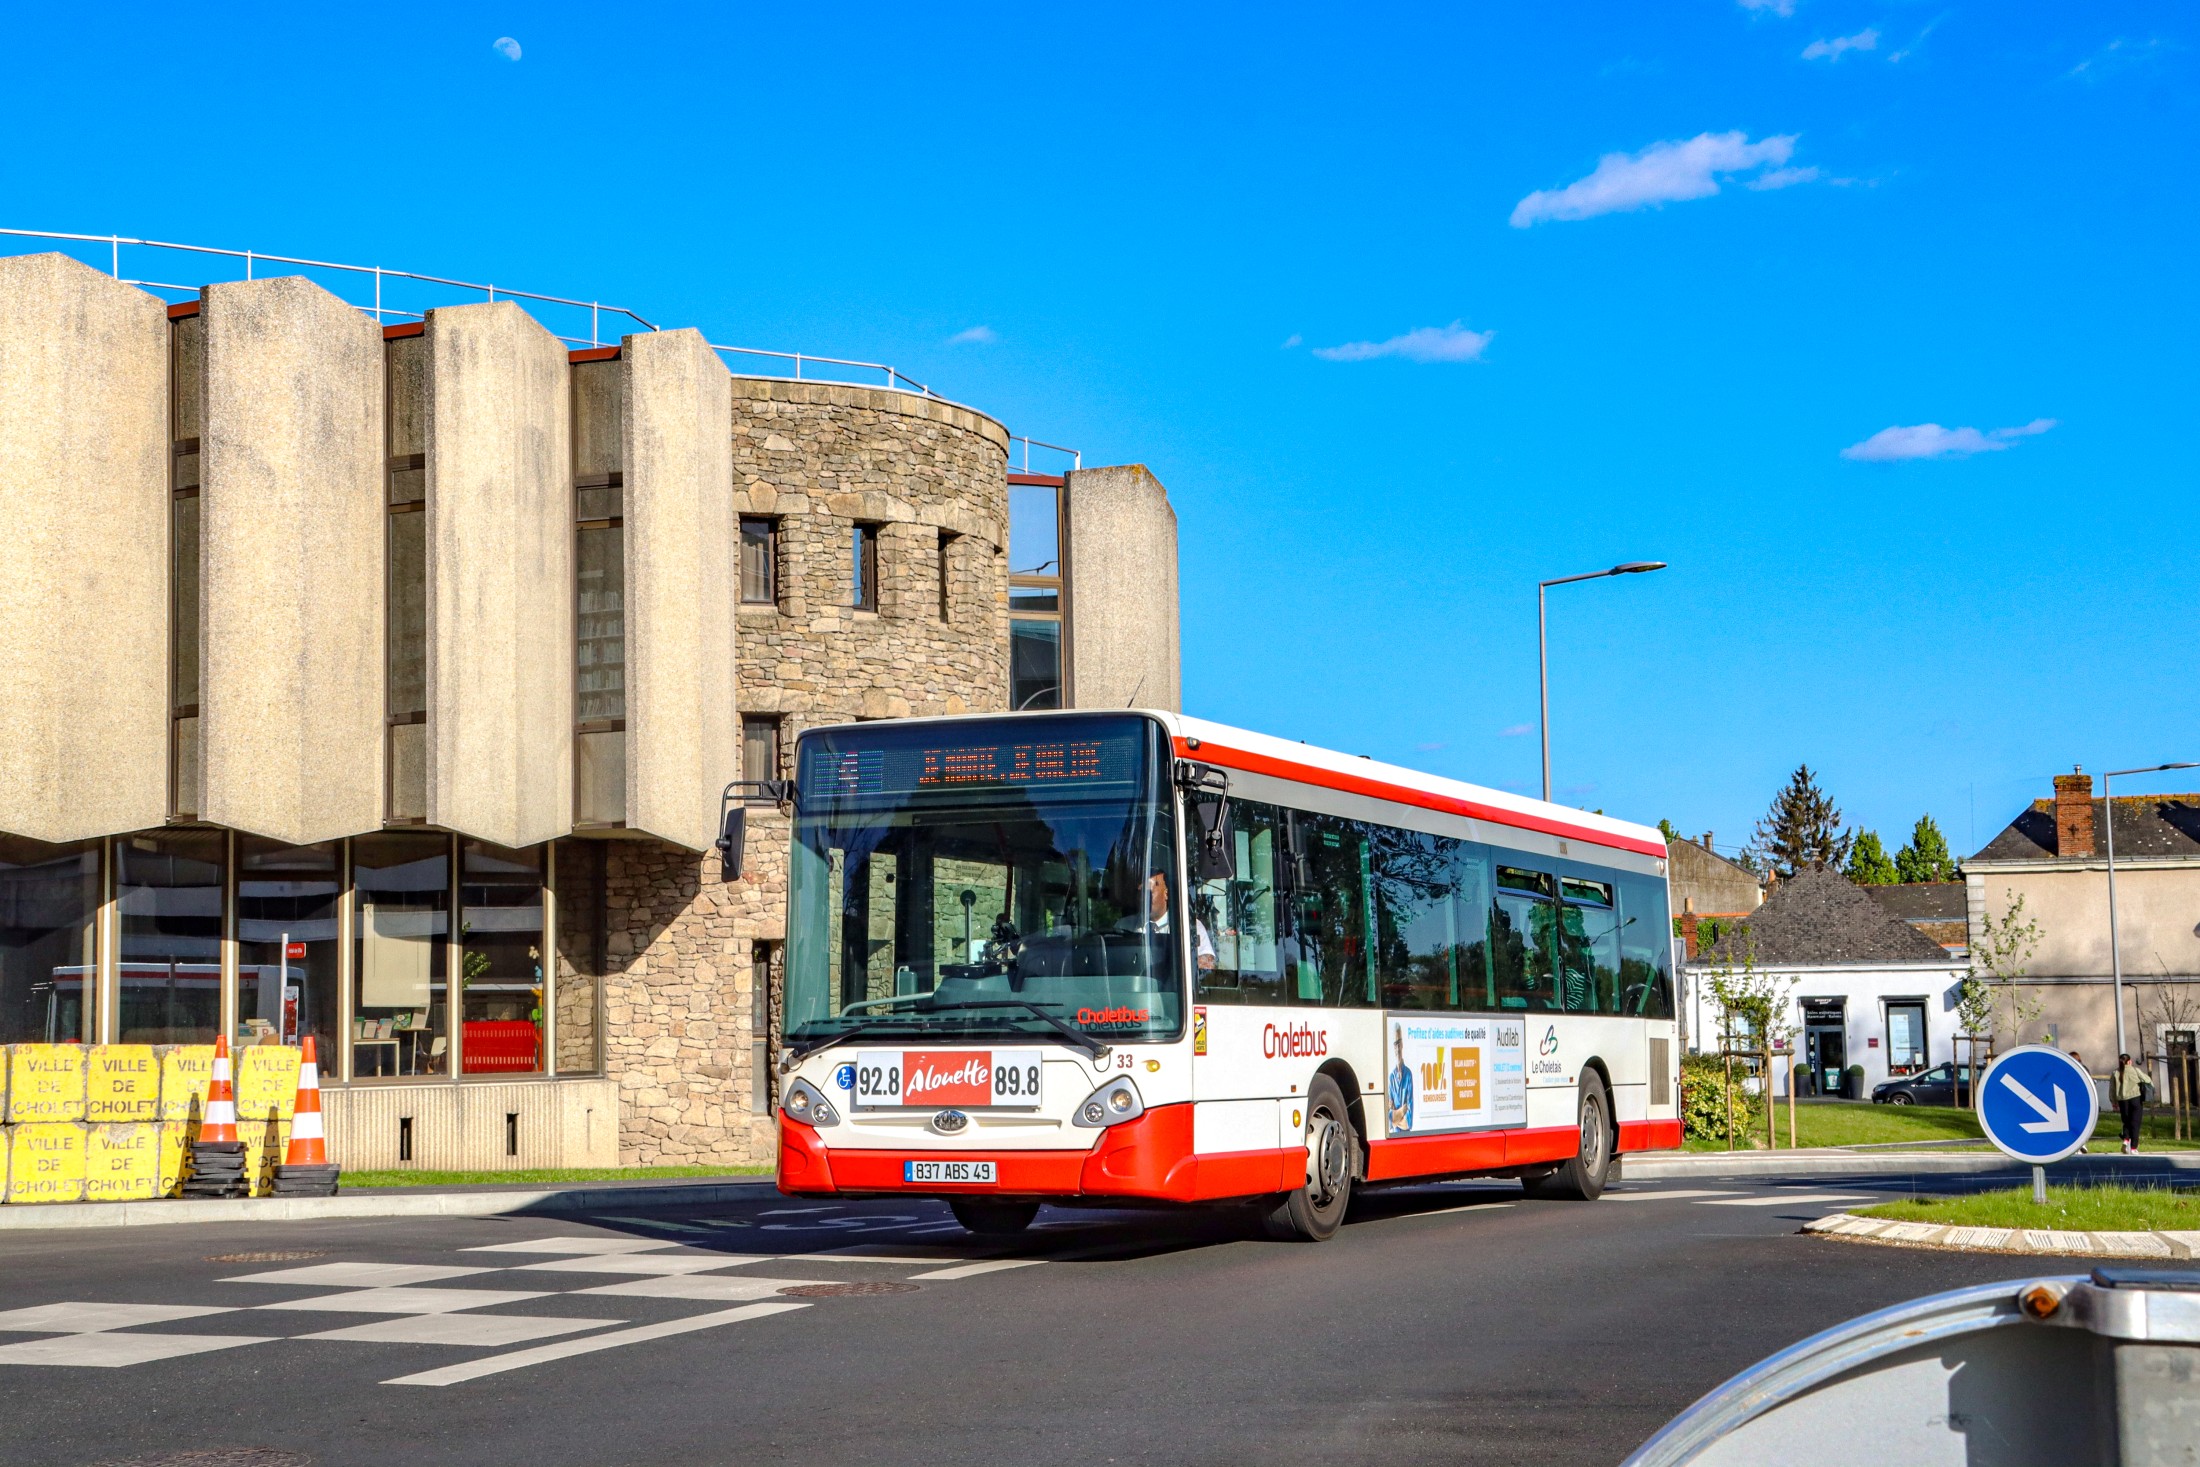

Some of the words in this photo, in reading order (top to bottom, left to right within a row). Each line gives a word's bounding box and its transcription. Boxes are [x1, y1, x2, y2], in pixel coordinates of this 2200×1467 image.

[1077, 1006, 1150, 1025] Choletbus
[1263, 1021, 1328, 1059] Choletbus
[1465, 1027, 1471, 1040] de
[1471, 1026, 1486, 1042] qualité
[1497, 1027, 1519, 1047] Audilab
[27, 1059, 74, 1072] VILLE
[102, 1059, 147, 1072] VILLE
[253, 1059, 295, 1072] VILLE
[1117, 1054, 1134, 1069] 33
[1532, 1060, 1540, 1074] Le
[1539, 1060, 1562, 1074] Choletais
[859, 1066, 900, 1096] 92.8
[906, 1059, 989, 1097] Alouette
[995, 1065, 1040, 1096] 89.8
[1421, 1062, 1447, 1091] 100%
[38, 1080, 61, 1093] DE
[112, 1080, 135, 1093] DE
[263, 1080, 284, 1091] DE
[13, 1101, 84, 1115] CHOLET
[90, 1100, 156, 1114] CHOLET
[27, 1137, 74, 1151] VILLE
[101, 1136, 146, 1150] VILLE
[38, 1158, 61, 1172] DE
[111, 1157, 134, 1171] DE
[258, 1155, 279, 1168] DE
[916, 1163, 940, 1180] 837
[944, 1163, 969, 1180] ABS
[973, 1163, 990, 1180] 49
[13, 1177, 85, 1194] CHOLET
[88, 1177, 153, 1192] CHOLET
